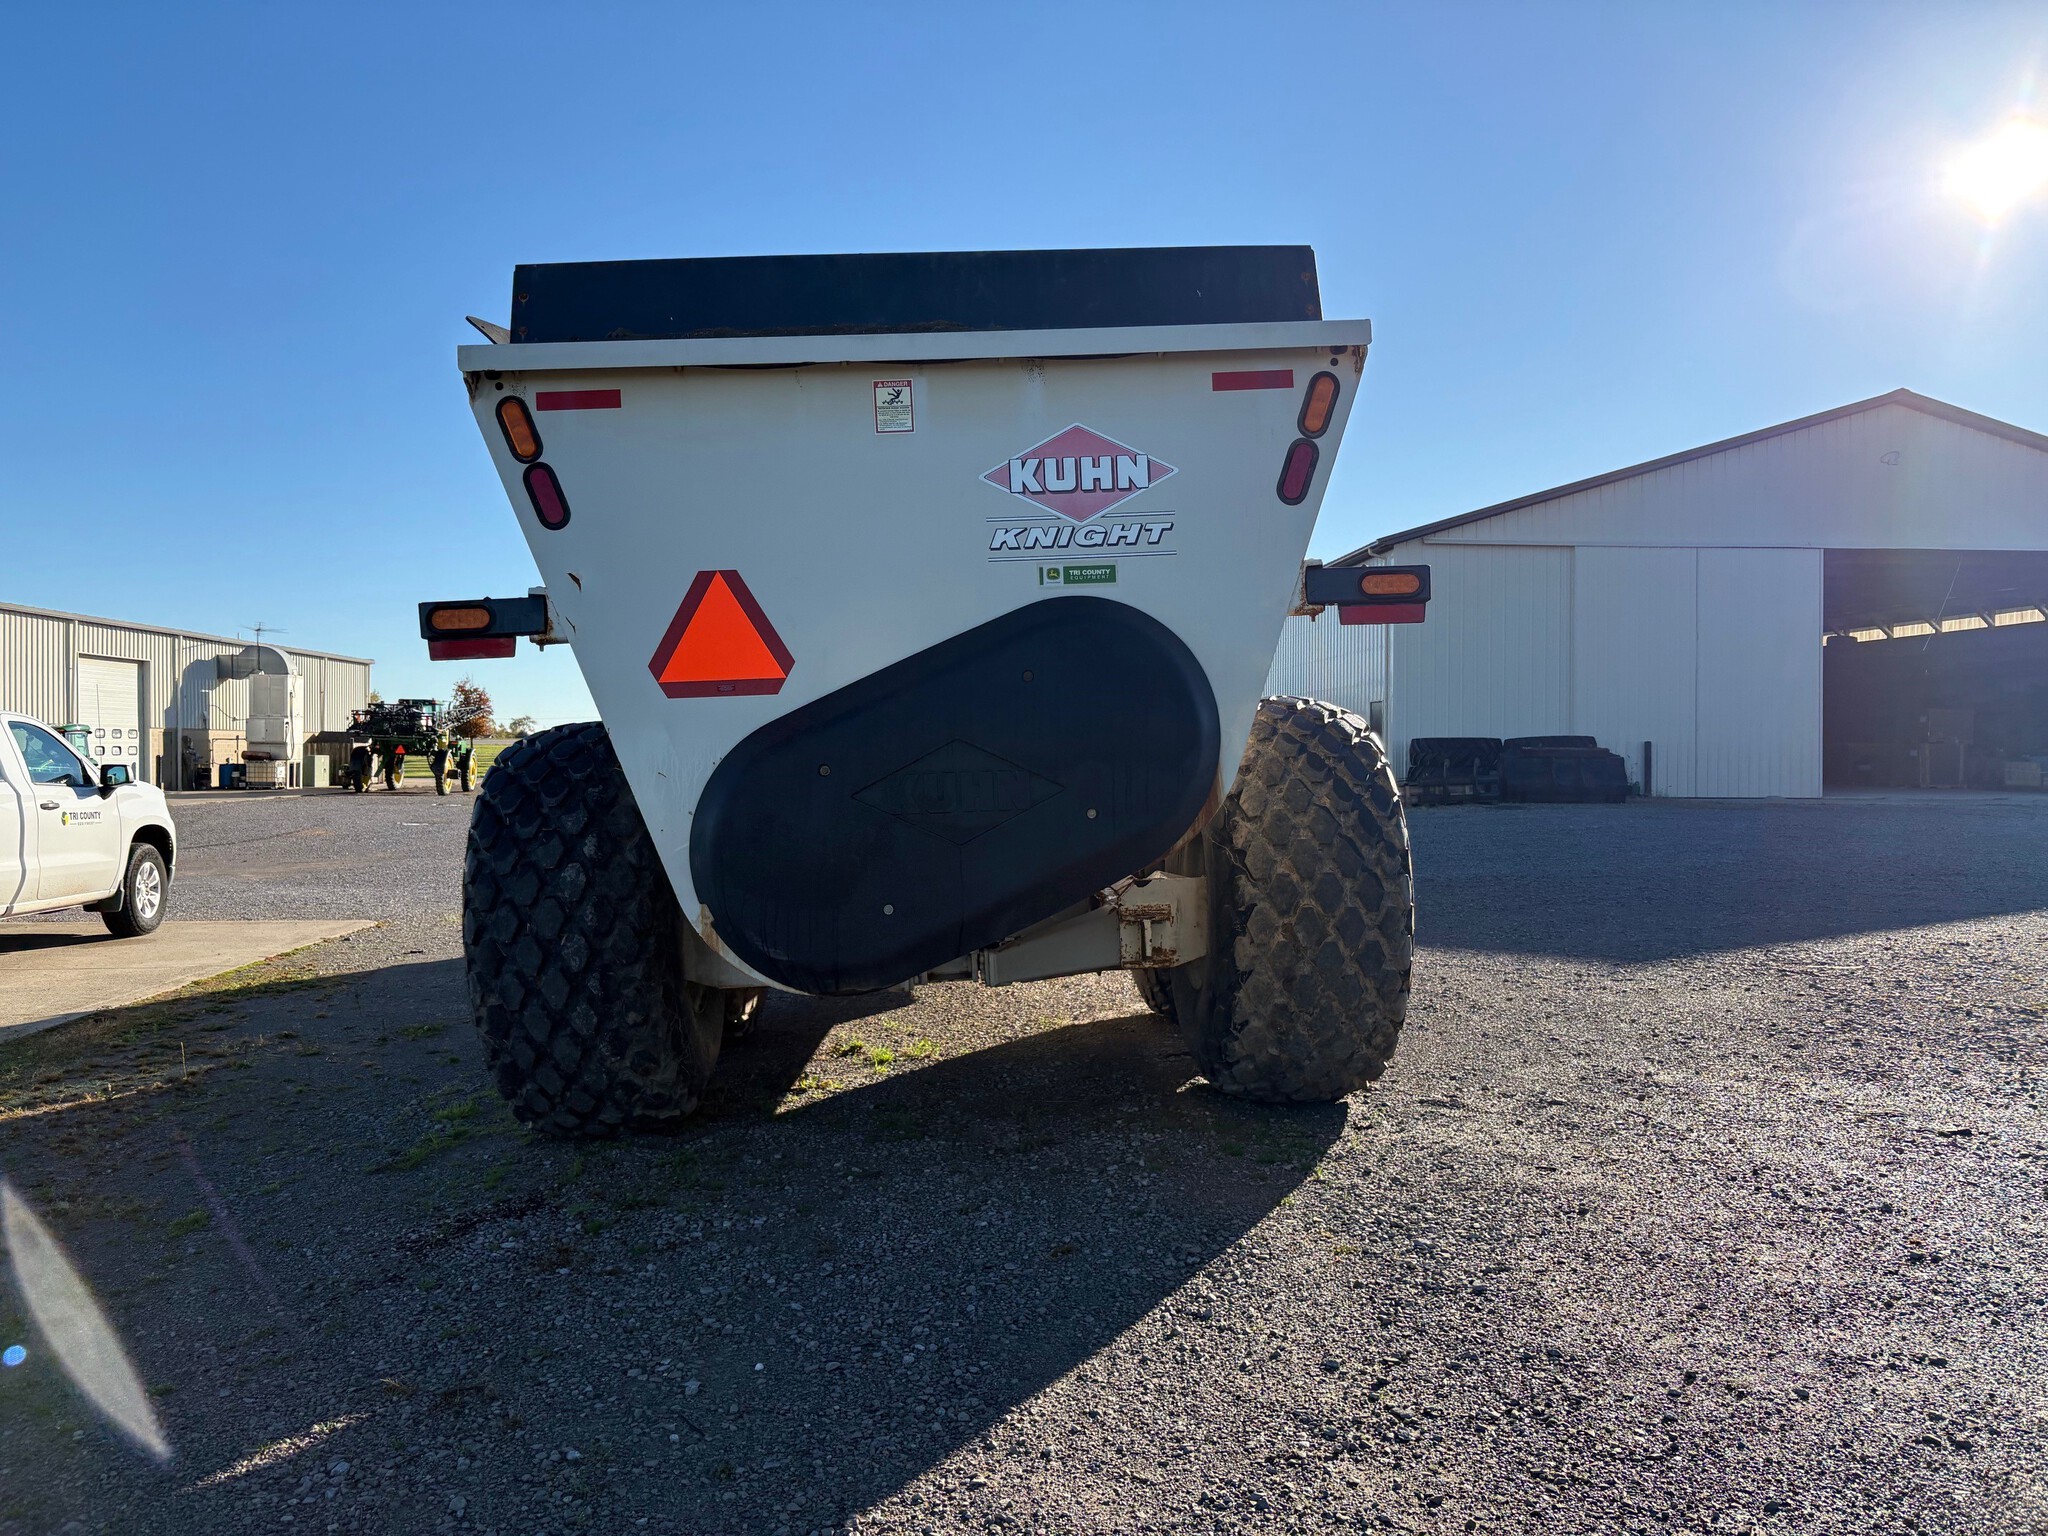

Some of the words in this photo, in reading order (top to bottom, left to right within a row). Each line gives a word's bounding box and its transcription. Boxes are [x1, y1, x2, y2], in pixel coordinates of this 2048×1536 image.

[1008, 453, 1151, 495] KUHN
[989, 522, 1175, 551] KNIGHT
[1082, 568, 1111, 576] COUNTY
[69, 812, 78, 820] TRI
[80, 811, 101, 820] COUNTY
